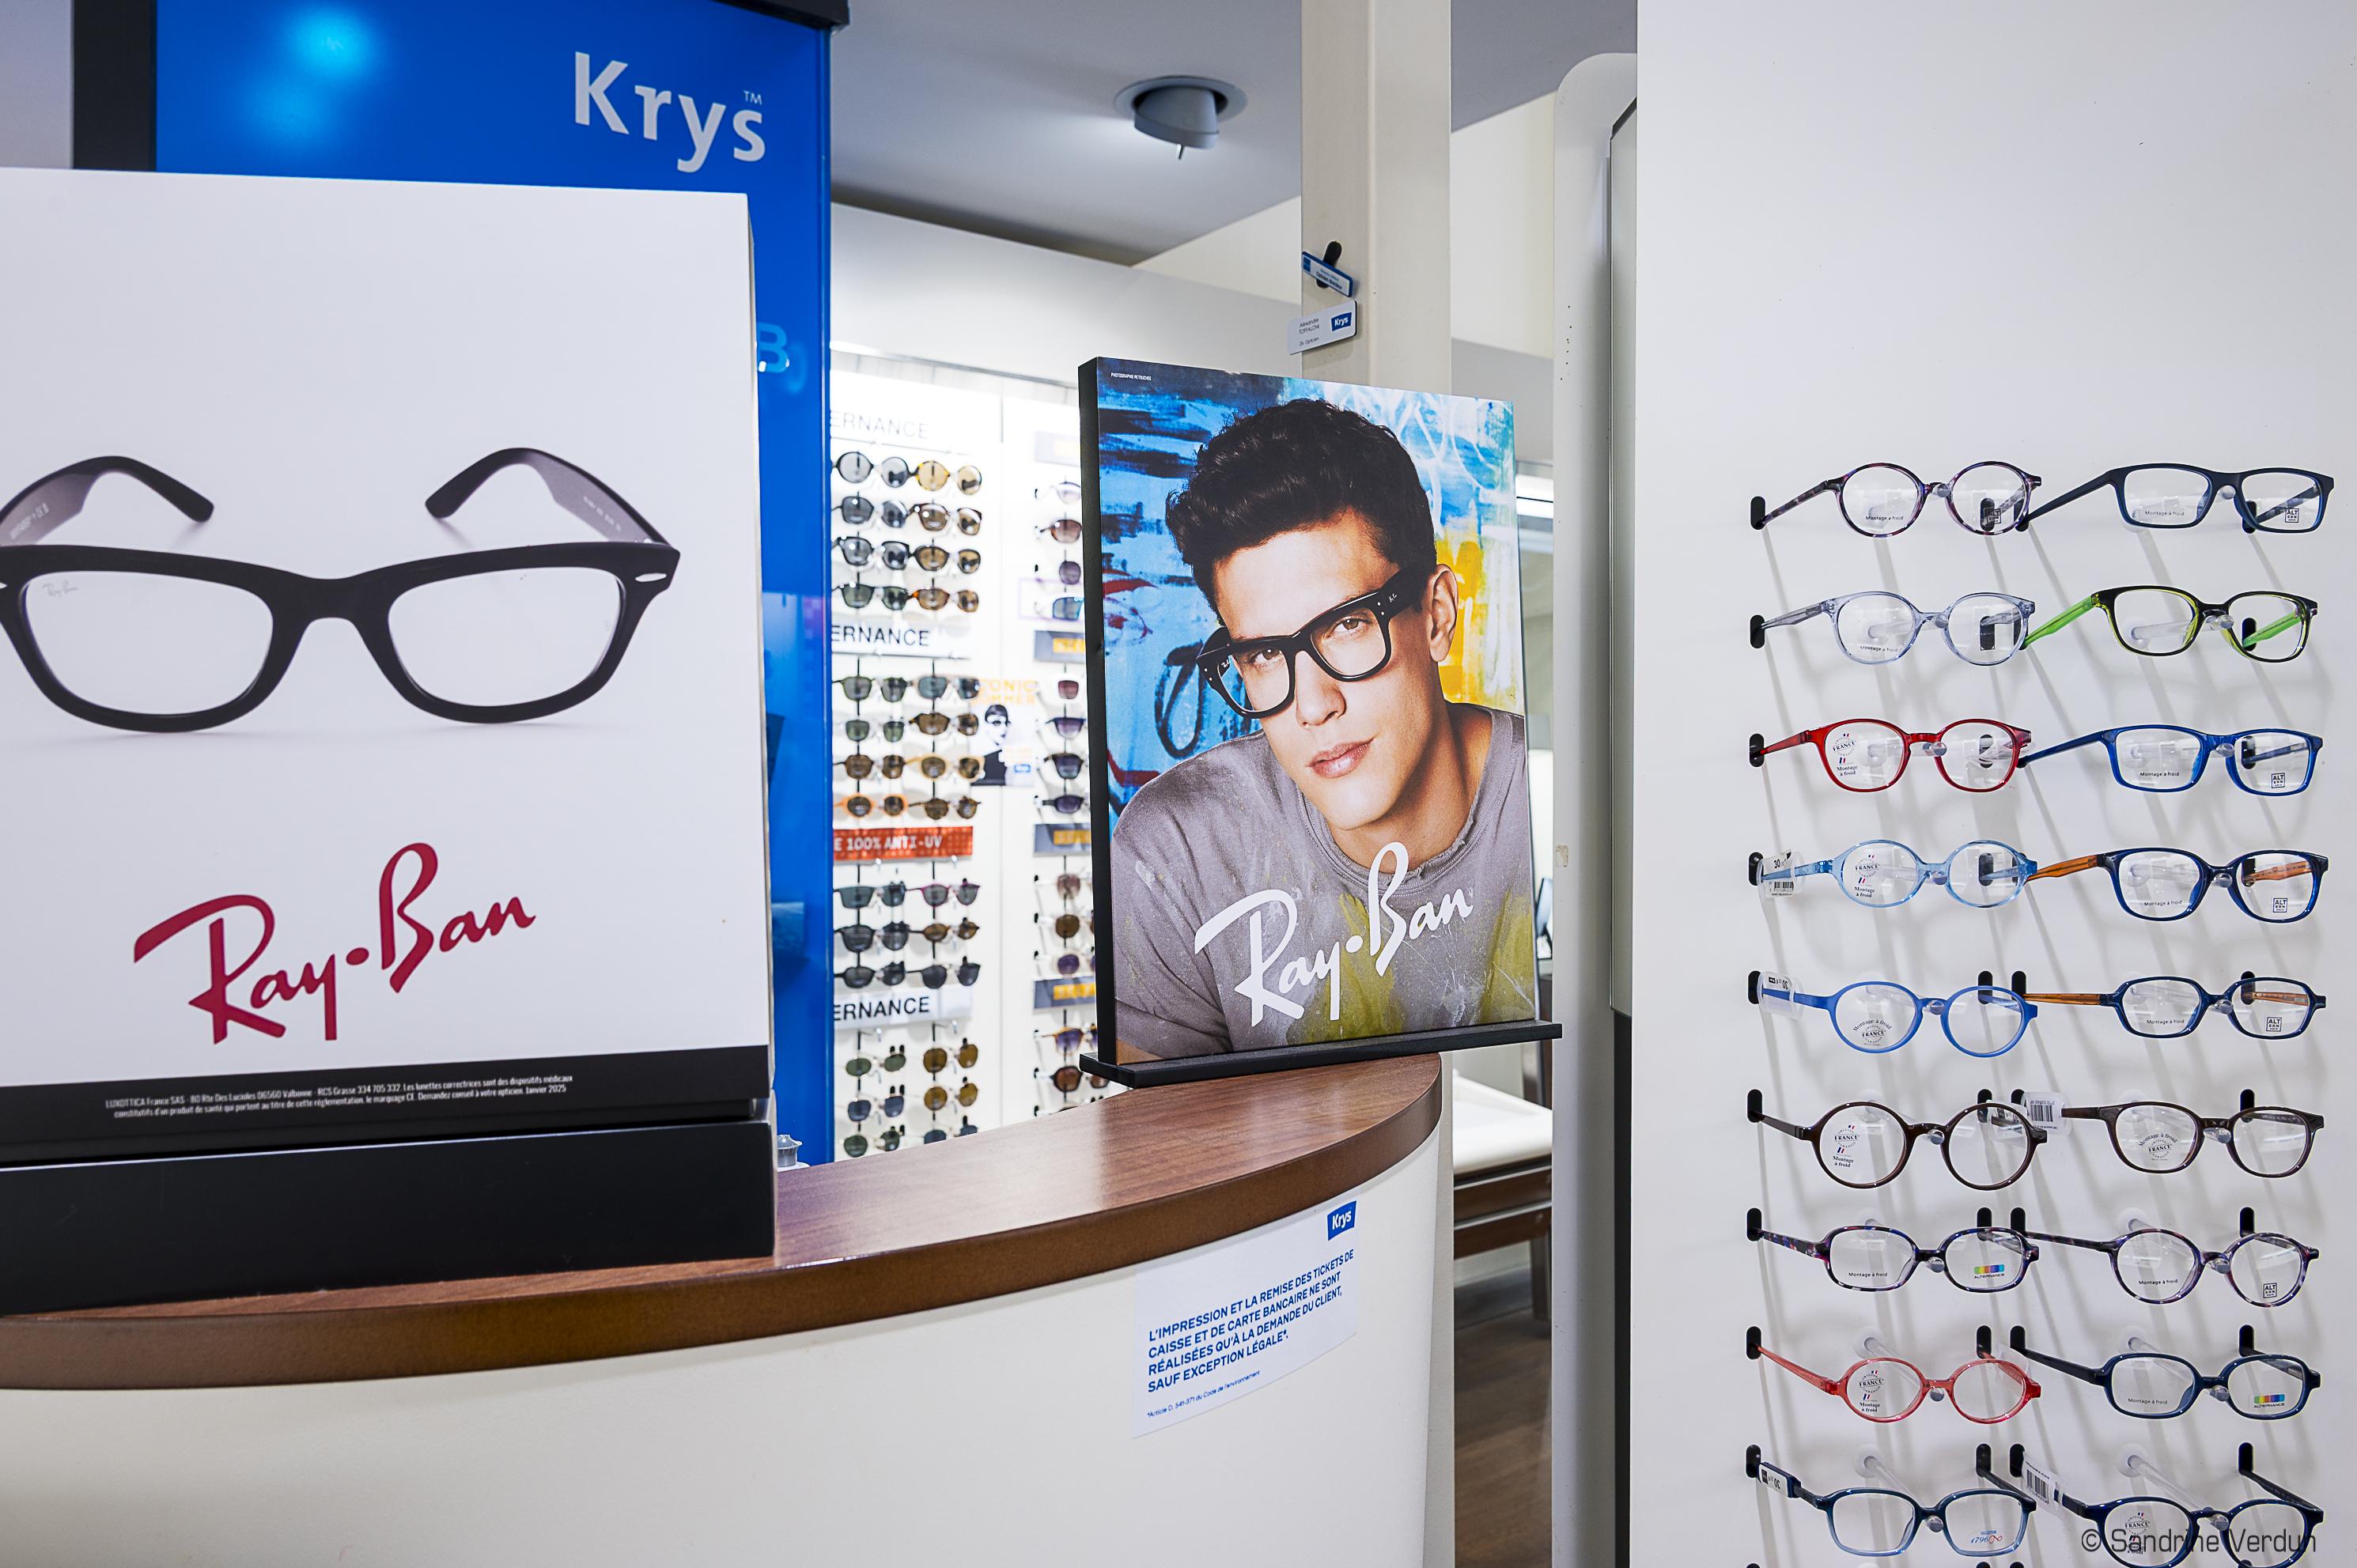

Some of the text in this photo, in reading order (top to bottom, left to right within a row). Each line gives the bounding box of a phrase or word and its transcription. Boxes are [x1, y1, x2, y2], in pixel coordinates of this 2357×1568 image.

[575, 51, 766, 172] Krys
[1334, 317, 1348, 326] Krys
[846, 836, 881, 850] 100%
[883, 835, 943, 849] ANTI-UV
[1773, 859, 1780, 868] 30
[333, 1086, 356, 1095] Grasse
[358, 1085, 371, 1094] 334
[373, 1083, 386, 1093] 705
[403, 1082, 415, 1091] Les
[443, 1080, 482, 1090] correctrices
[509, 1076, 542, 1086] dispositifs
[548, 1083, 566, 1093] 2025
[1332, 1211, 1352, 1230] Krys
[1149, 1249, 1354, 1342] L'IMPRESSION ET LA REMISE DES TICKETS DE
[1148, 1271, 1341, 1358] CAISSE ET DE CARTE BANCAIRE NE SONT
[1148, 1286, 1342, 1376] RÉALISÉES QU'À LA DEMANDE DU CLIENT,
[1148, 1372, 1180, 1392] SAUF
[1184, 1348, 1244, 1381] EXCEPTION
[1203, 1389, 1216, 1399] Code
